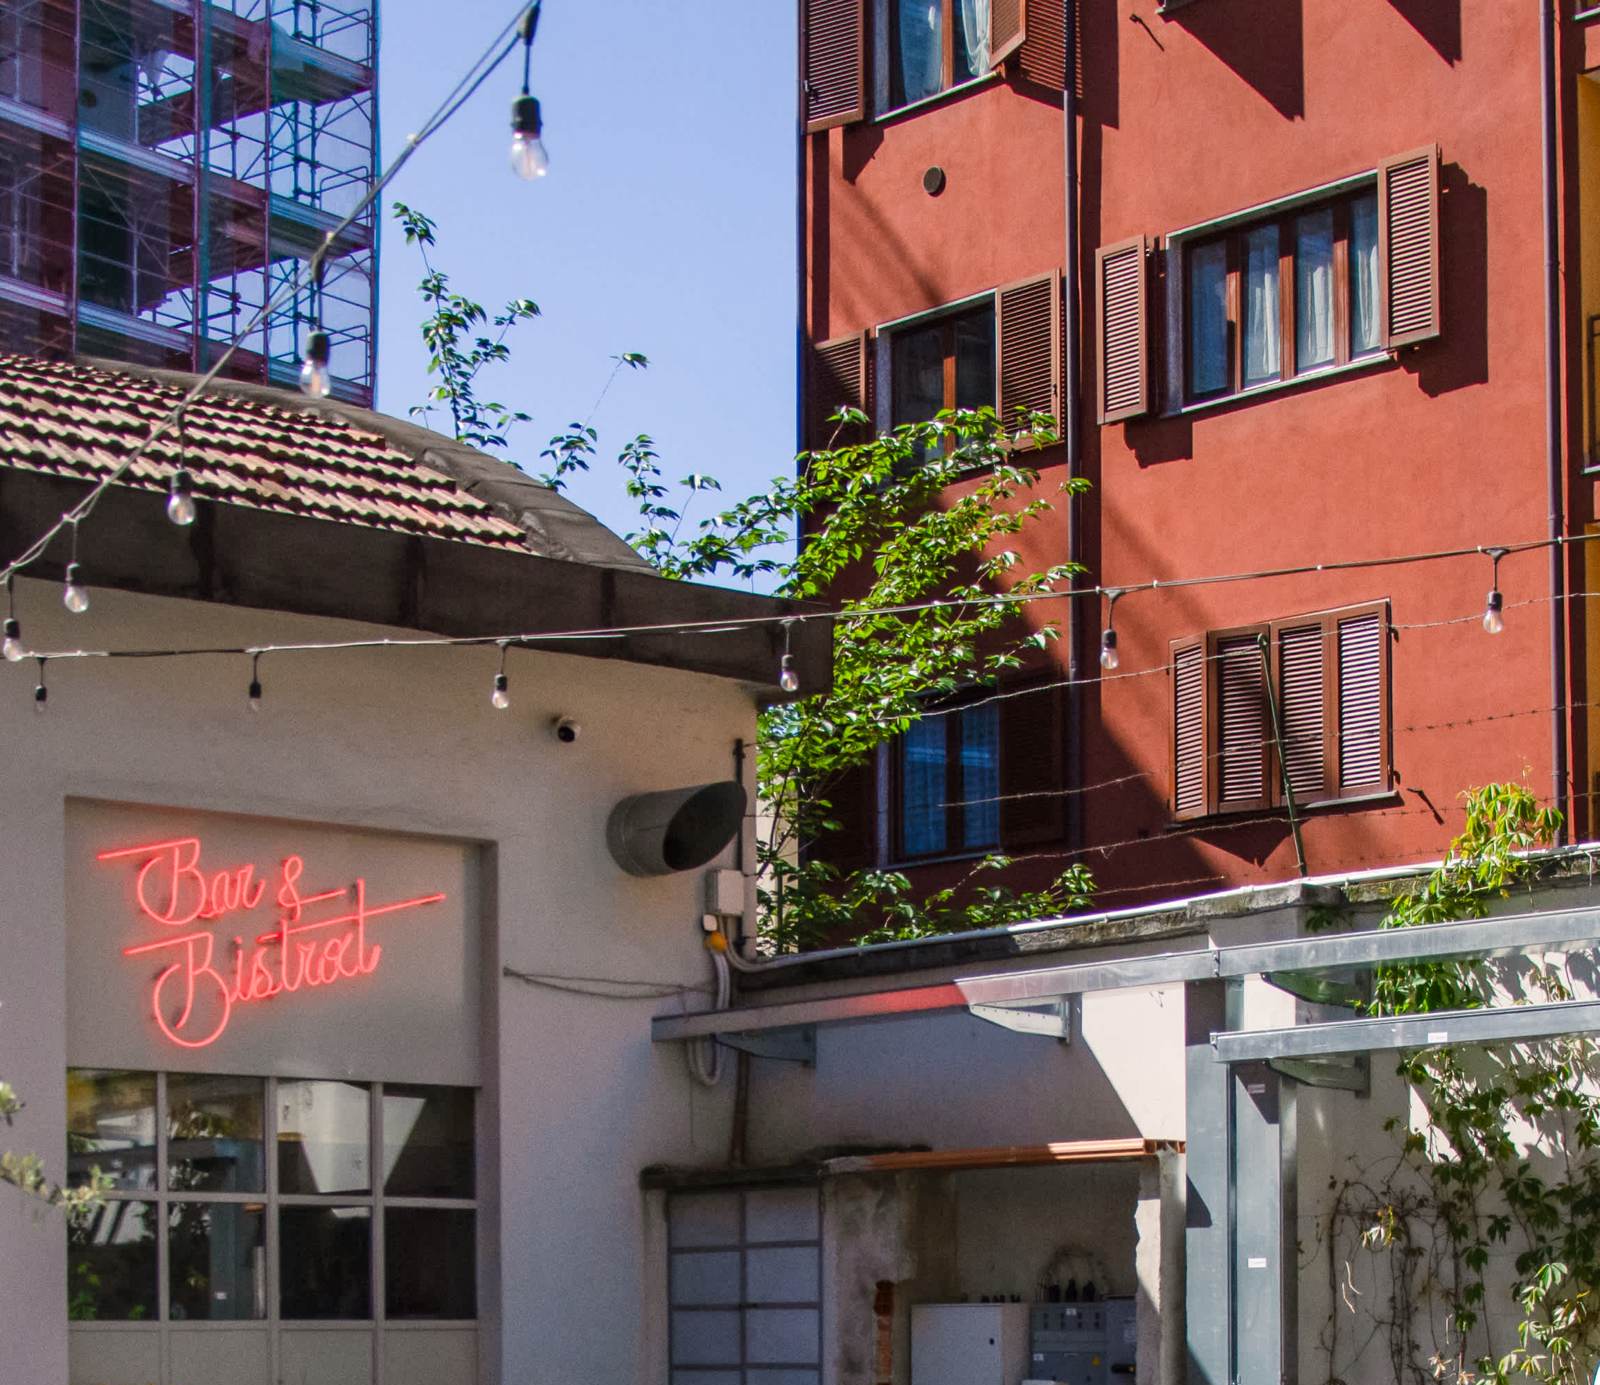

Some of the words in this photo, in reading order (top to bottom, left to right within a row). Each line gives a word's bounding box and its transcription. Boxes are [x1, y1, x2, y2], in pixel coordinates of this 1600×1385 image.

[97, 838, 266, 925] Bar
[278, 856, 347, 921] &
[124, 879, 446, 1048] Bistrot
